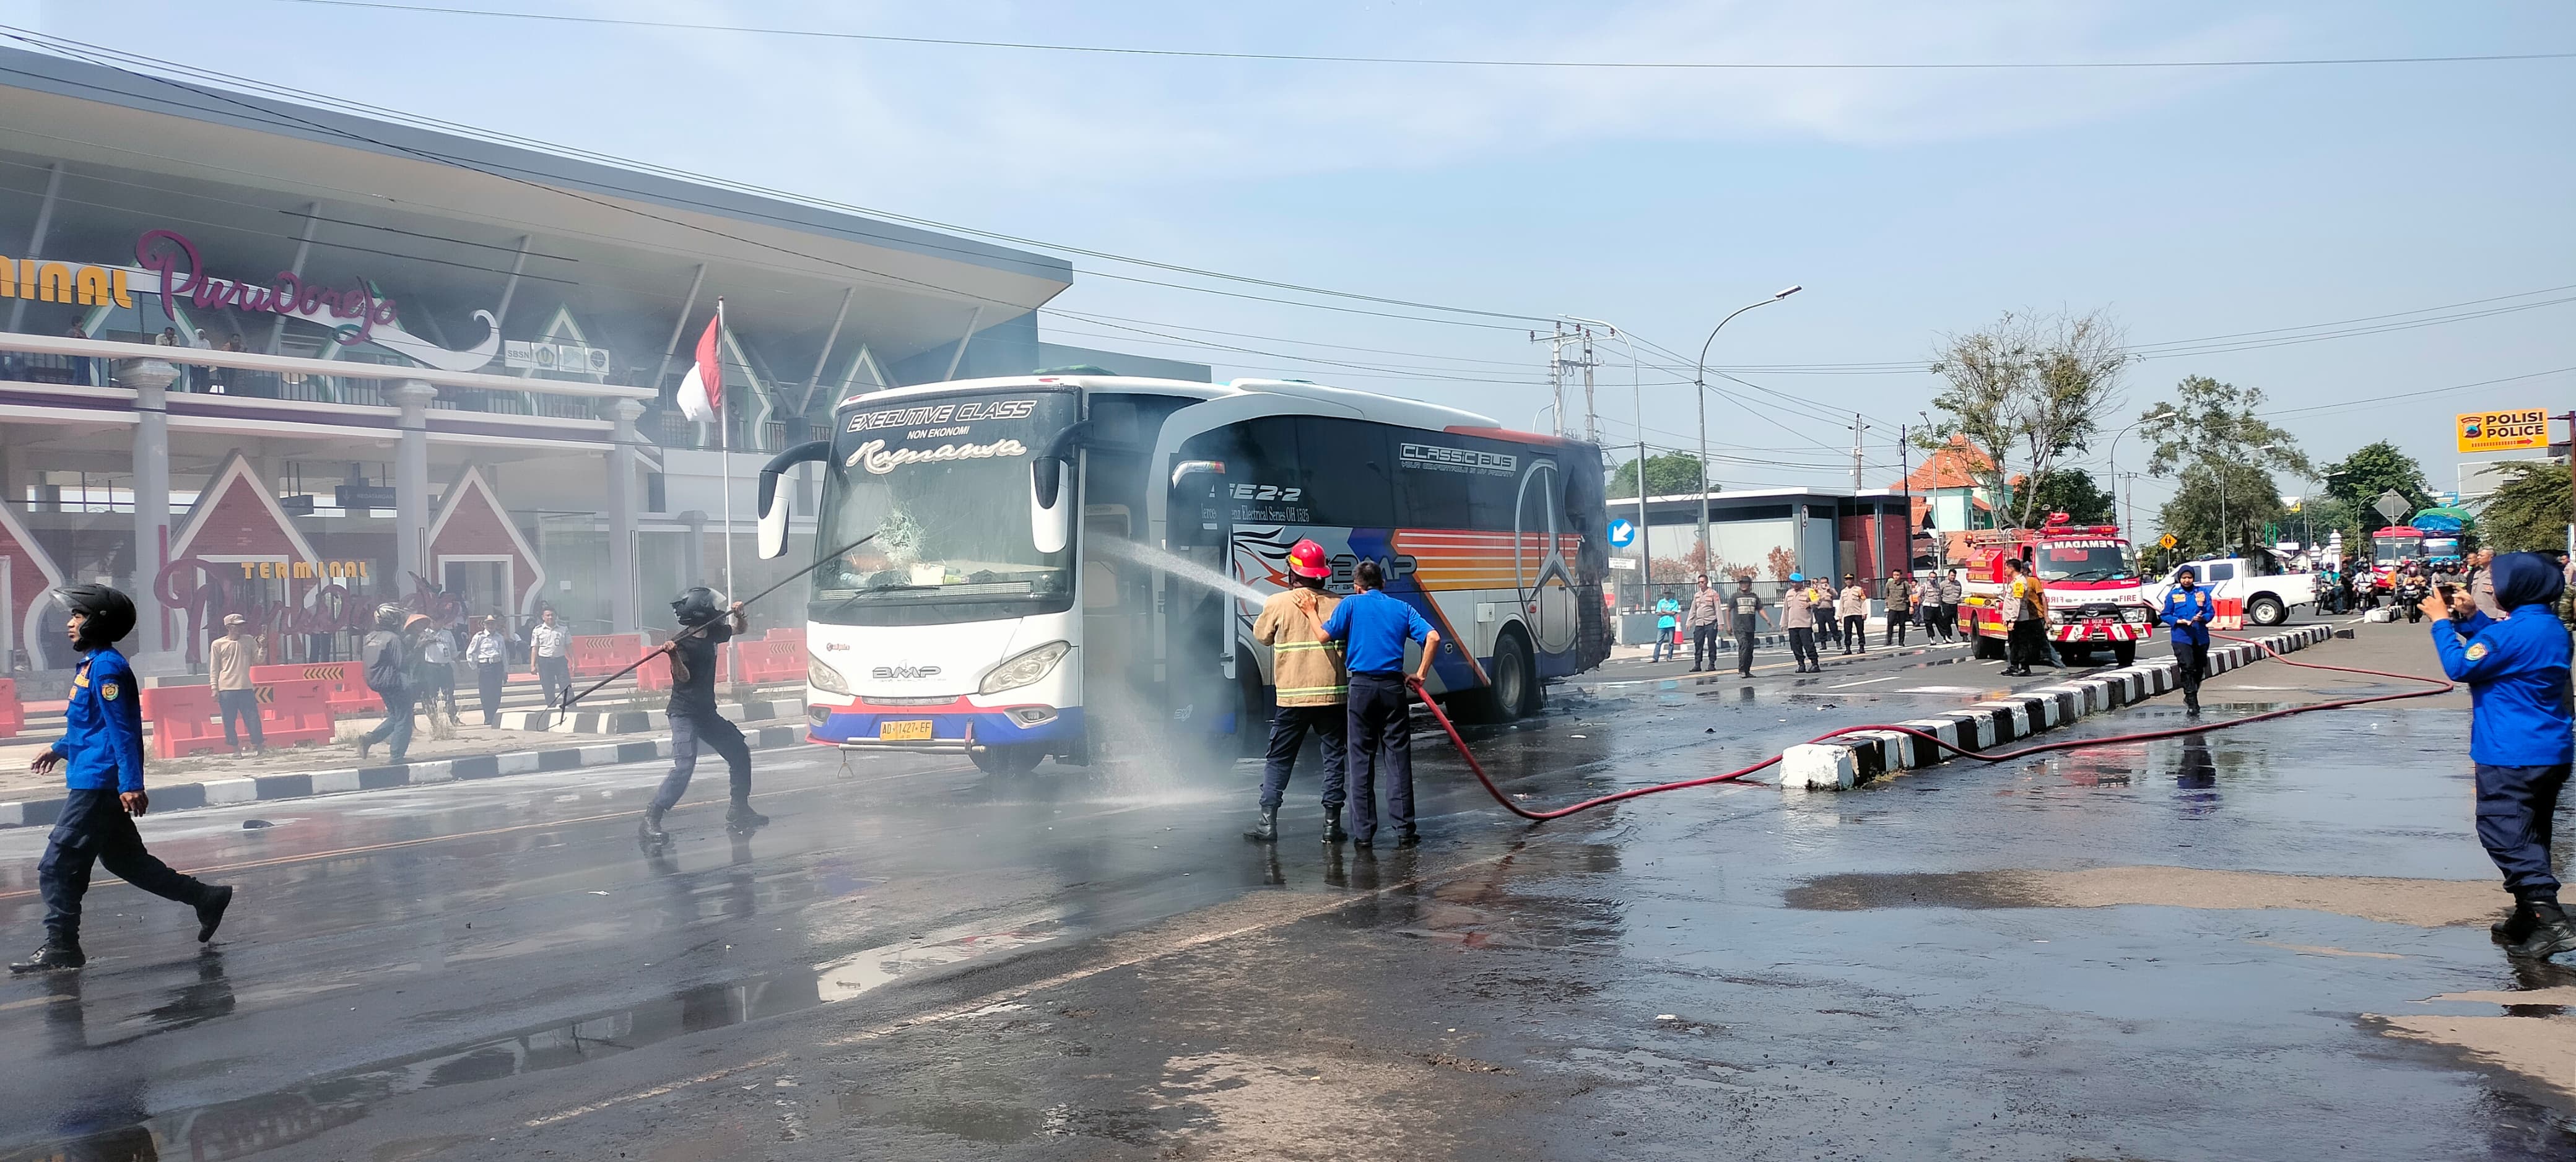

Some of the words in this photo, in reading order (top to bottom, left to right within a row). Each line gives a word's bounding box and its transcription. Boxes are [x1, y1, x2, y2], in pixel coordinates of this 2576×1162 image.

[507, 350, 530, 358] SBSN
[846, 404, 955, 433] EXECUTIVE
[954, 401, 1037, 422] CLASS
[2486, 412, 2543, 425] POLISI
[907, 430, 928, 440] NON
[928, 426, 970, 437] EKONOMI
[2486, 425, 2544, 438] POLICE
[1481, 455, 1512, 467] BUS
[1242, 505, 1268, 521] Electrical
[1268, 506, 1286, 521] Series
[1286, 507, 1296, 521] OH
[1297, 508, 1309, 522] 1525
[242, 561, 368, 579] TERMINAL
[872, 666, 941, 679] BMP
[882, 724, 892, 734] AD
[899, 722, 916, 734] 1427
[920, 722, 932, 733] EF
